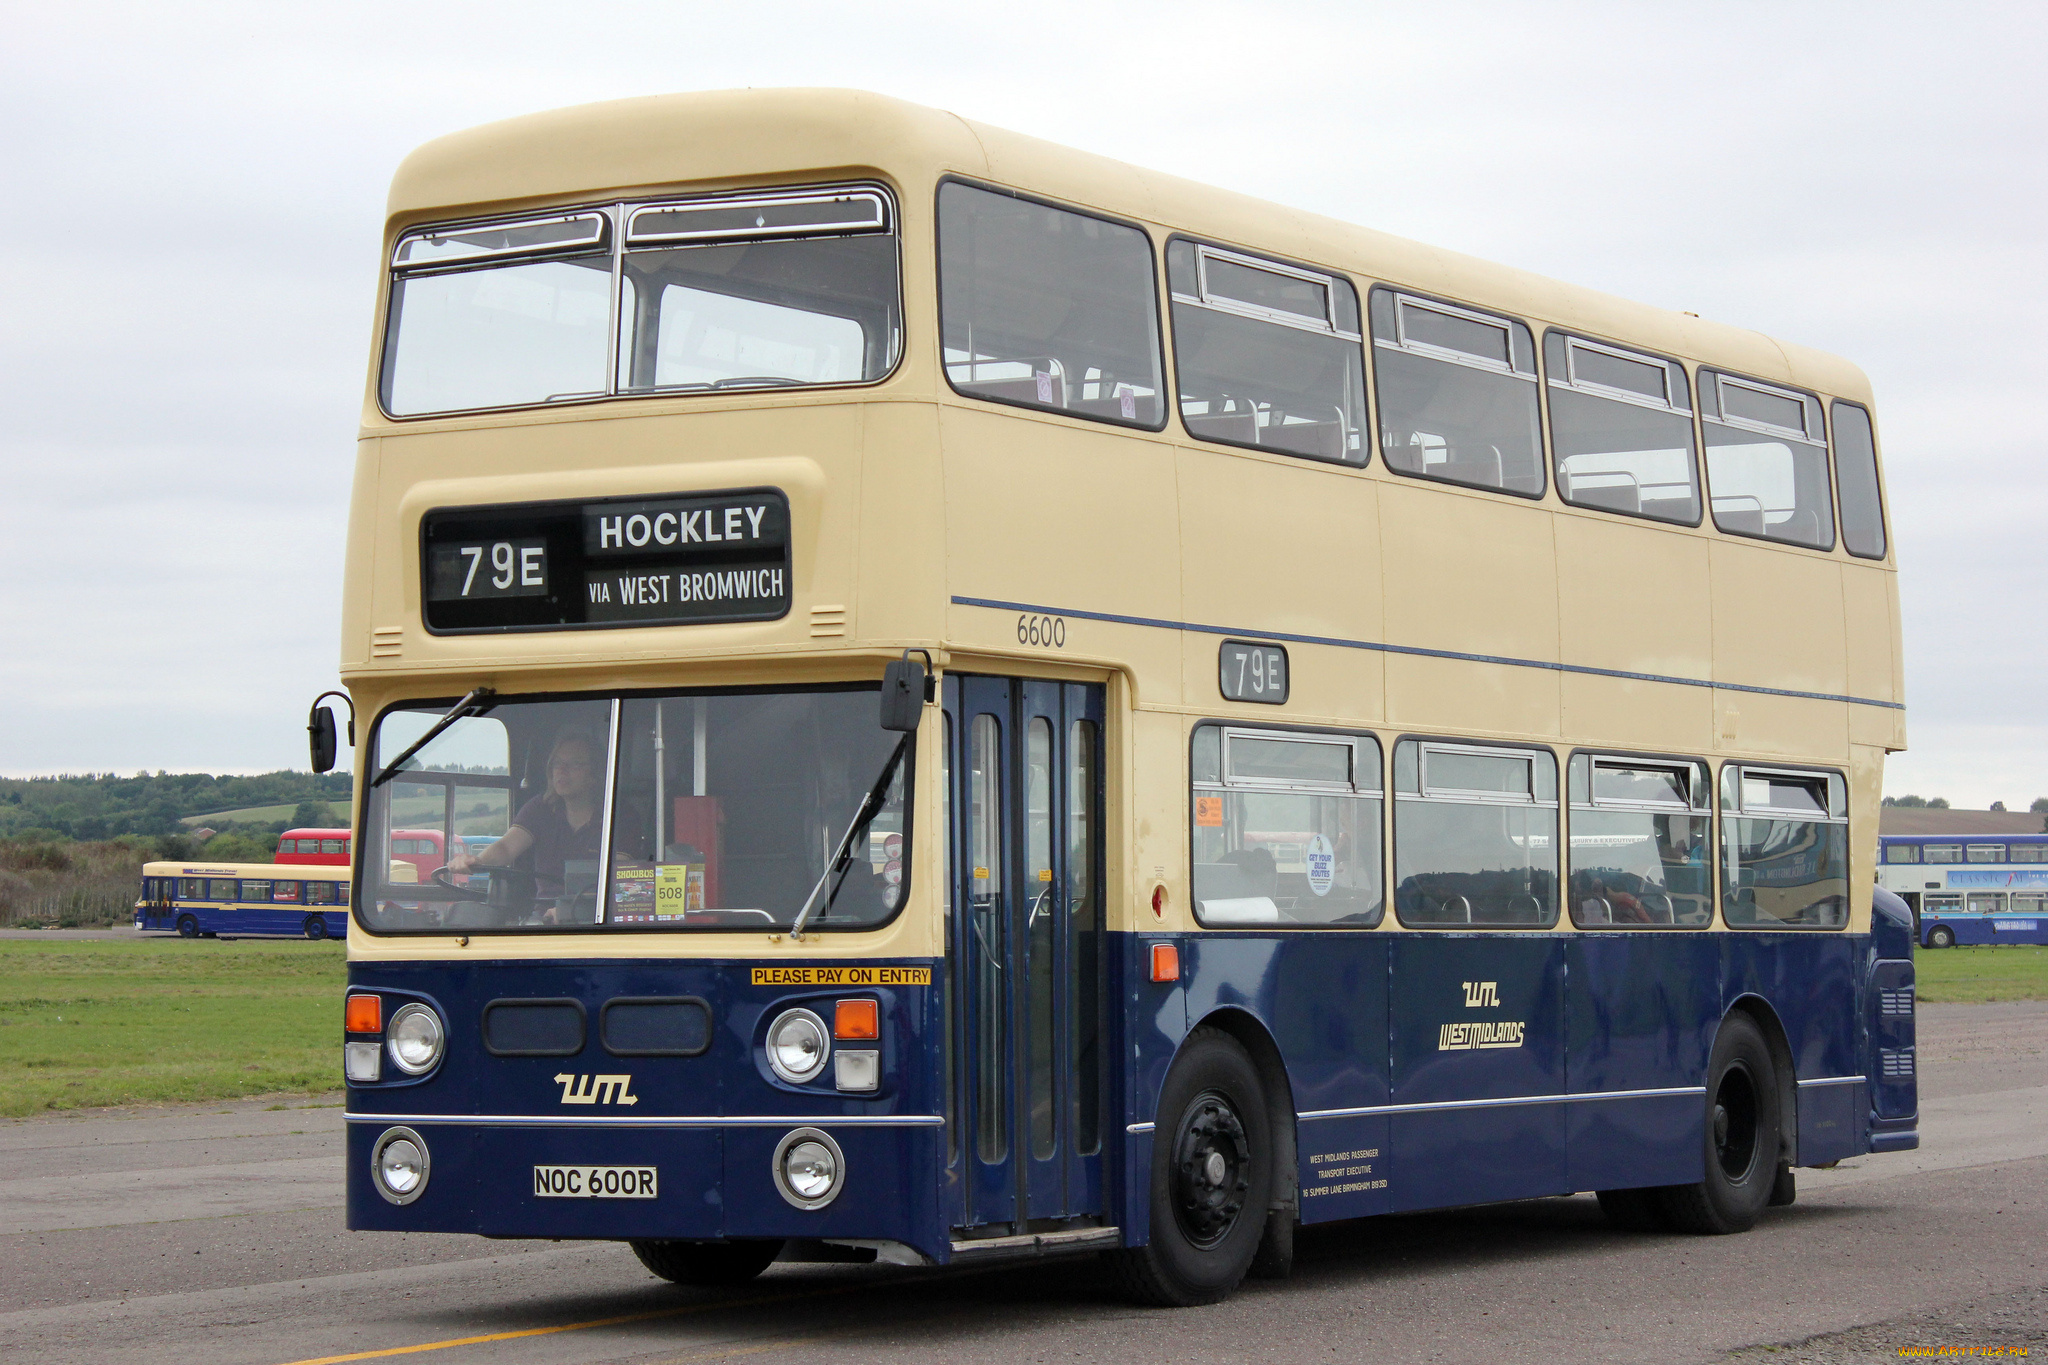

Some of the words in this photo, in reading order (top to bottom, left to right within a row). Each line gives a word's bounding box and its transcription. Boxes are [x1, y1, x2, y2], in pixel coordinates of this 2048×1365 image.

[600, 506, 766, 549] HOCKLEY
[461, 542, 544, 596] 79E
[589, 583, 610, 603] VIA
[619, 575, 671, 605] WEST
[680, 569, 783, 602] BROMWICH
[1017, 614, 1065, 648] 6600
[1235, 649, 1280, 697] 79E
[1309, 854, 1318, 862] GET
[1319, 854, 1332, 862] YOUR
[1314, 862, 1327, 870] BUZZ
[616, 869, 654, 879] SHOWBUS
[1311, 869, 1330, 878] ROUTES
[659, 887, 682, 899] 508
[754, 969, 812, 983] PLEASE
[817, 969, 843, 983] PAY
[849, 968, 872, 983] ON
[879, 969, 929, 983] ENTRY
[1309, 1154, 1323, 1164] WEST
[1324, 1151, 1350, 1162] MIDLANDS
[1351, 1148, 1379, 1160] PASSENGER
[1318, 1167, 1345, 1179] TRANSPORT
[1346, 1164, 1372, 1176] EXECUTIVE
[535, 1168, 582, 1194] NOC
[588, 1169, 654, 1195] 600R
[1303, 1188, 1308, 1198] 16
[1309, 1186, 1330, 1197] SUMMER
[1330, 1184, 1342, 1195] LANE
[1342, 1181, 1371, 1193] BIRMINGHAM
